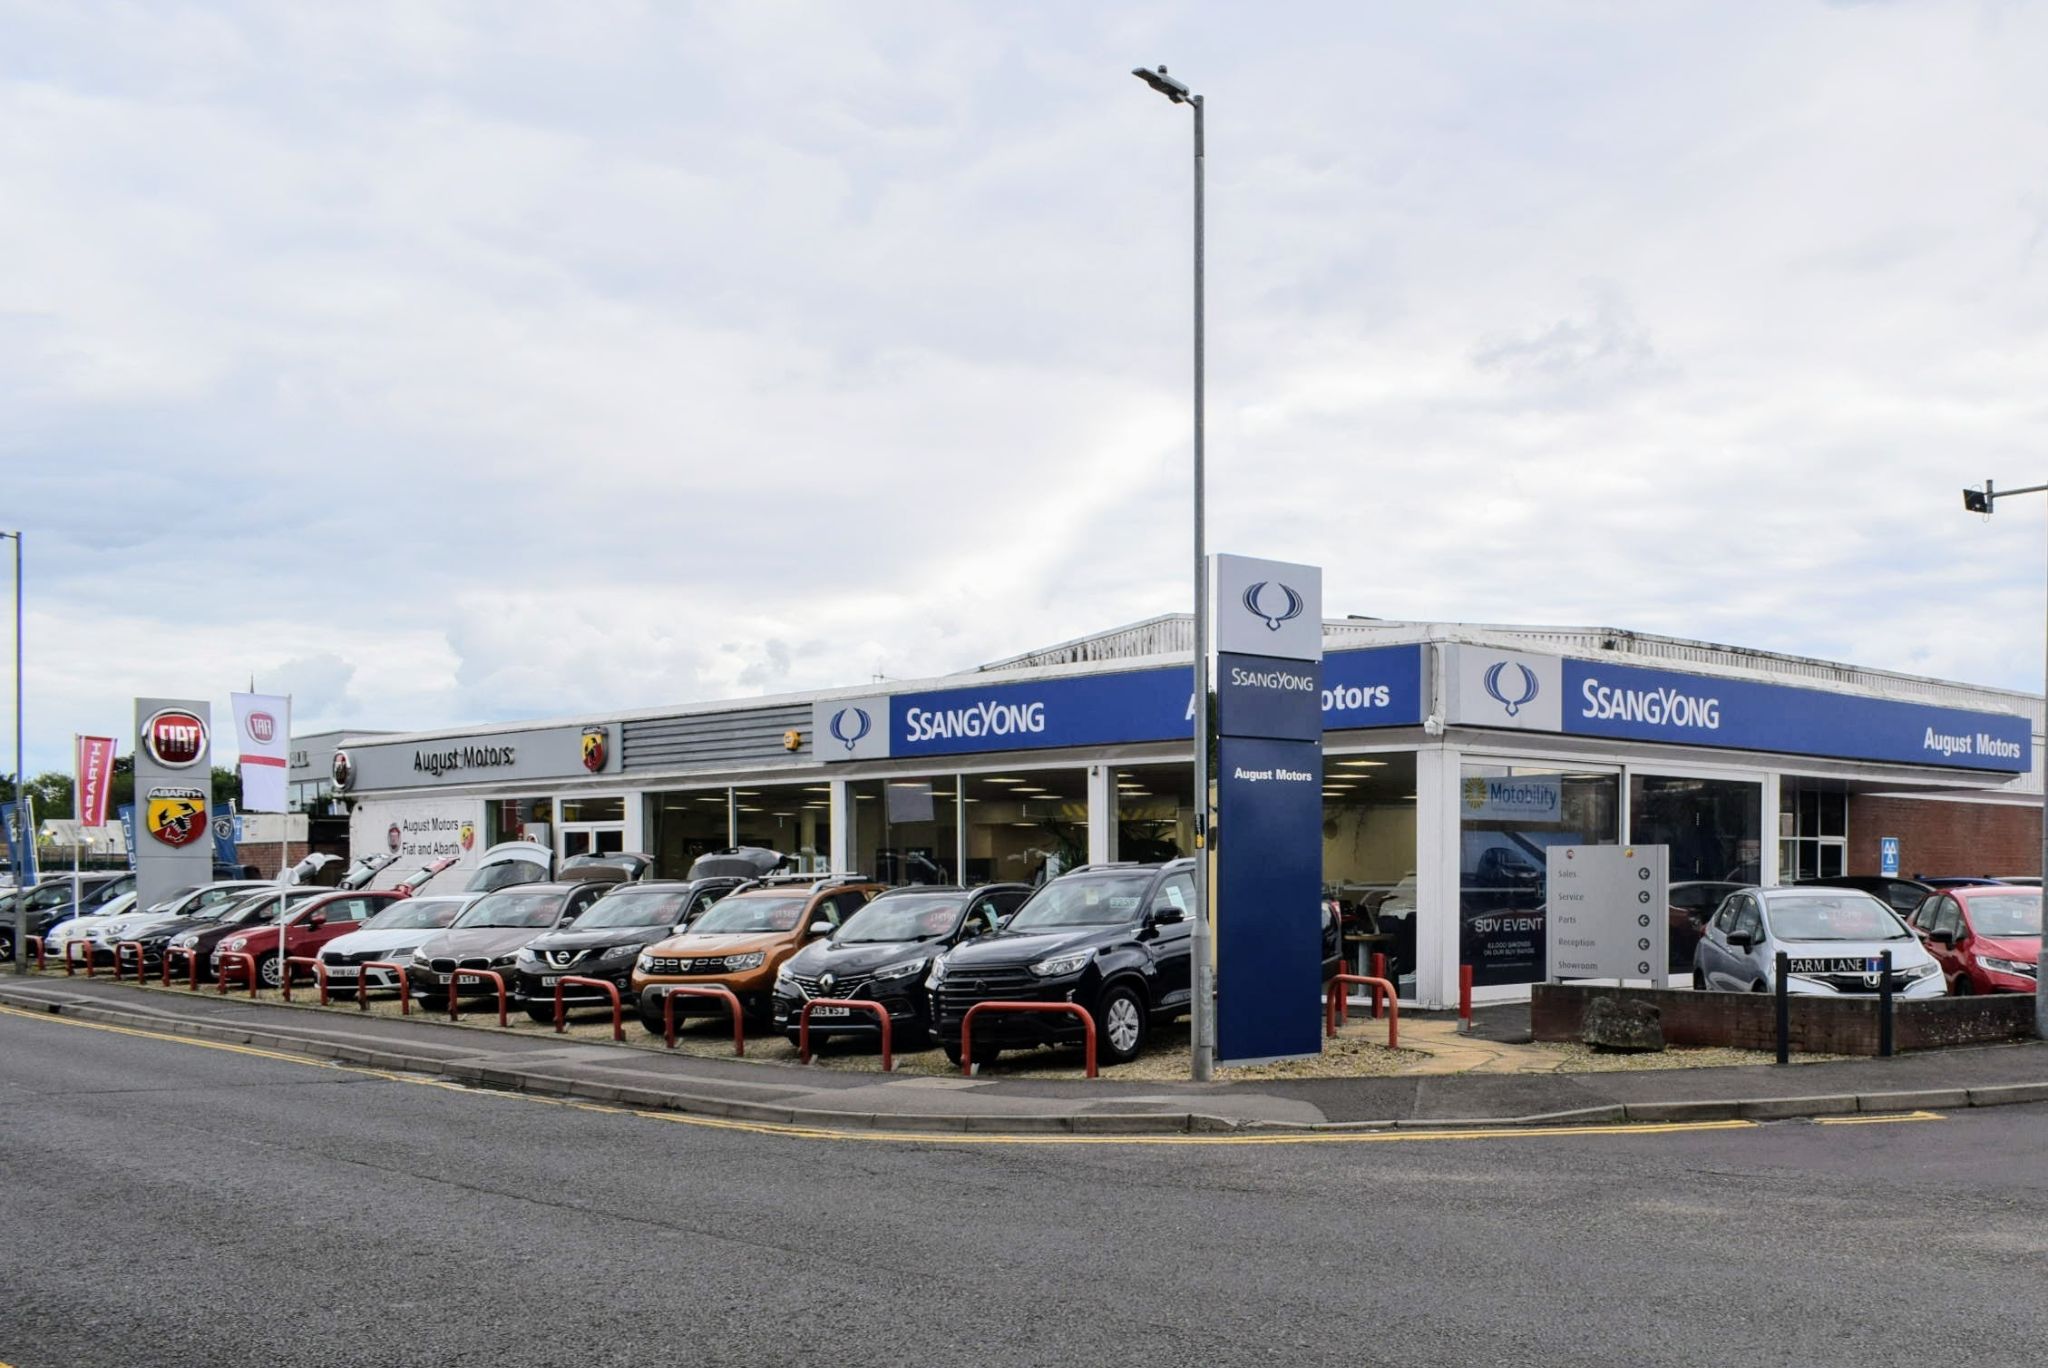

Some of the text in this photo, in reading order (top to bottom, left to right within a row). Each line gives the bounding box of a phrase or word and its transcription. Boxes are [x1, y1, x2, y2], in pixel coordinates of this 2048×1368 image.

[1321, 683, 1391, 712] otors
[159, 724, 198, 753] FIAT
[1923, 726, 2021, 759] August Motors
[414, 745, 514, 777] August Motors
[1234, 767, 1313, 782] August Motors
[85, 742, 102, 822] ABARTH
[151, 789, 203, 798] ABARTH
[403, 817, 459, 835] August Motors
[402, 842, 460, 855] Fiat and Abarth
[1558, 870, 1577, 878] Sales
[1558, 892, 1584, 901] Service
[1475, 917, 1544, 932] SUV EVENT
[1558, 916, 1577, 924] Parts
[1558, 938, 1596, 948] Reception
[1558, 961, 1598, 970] Showroom
[1790, 959, 1863, 972] FARM LANE
